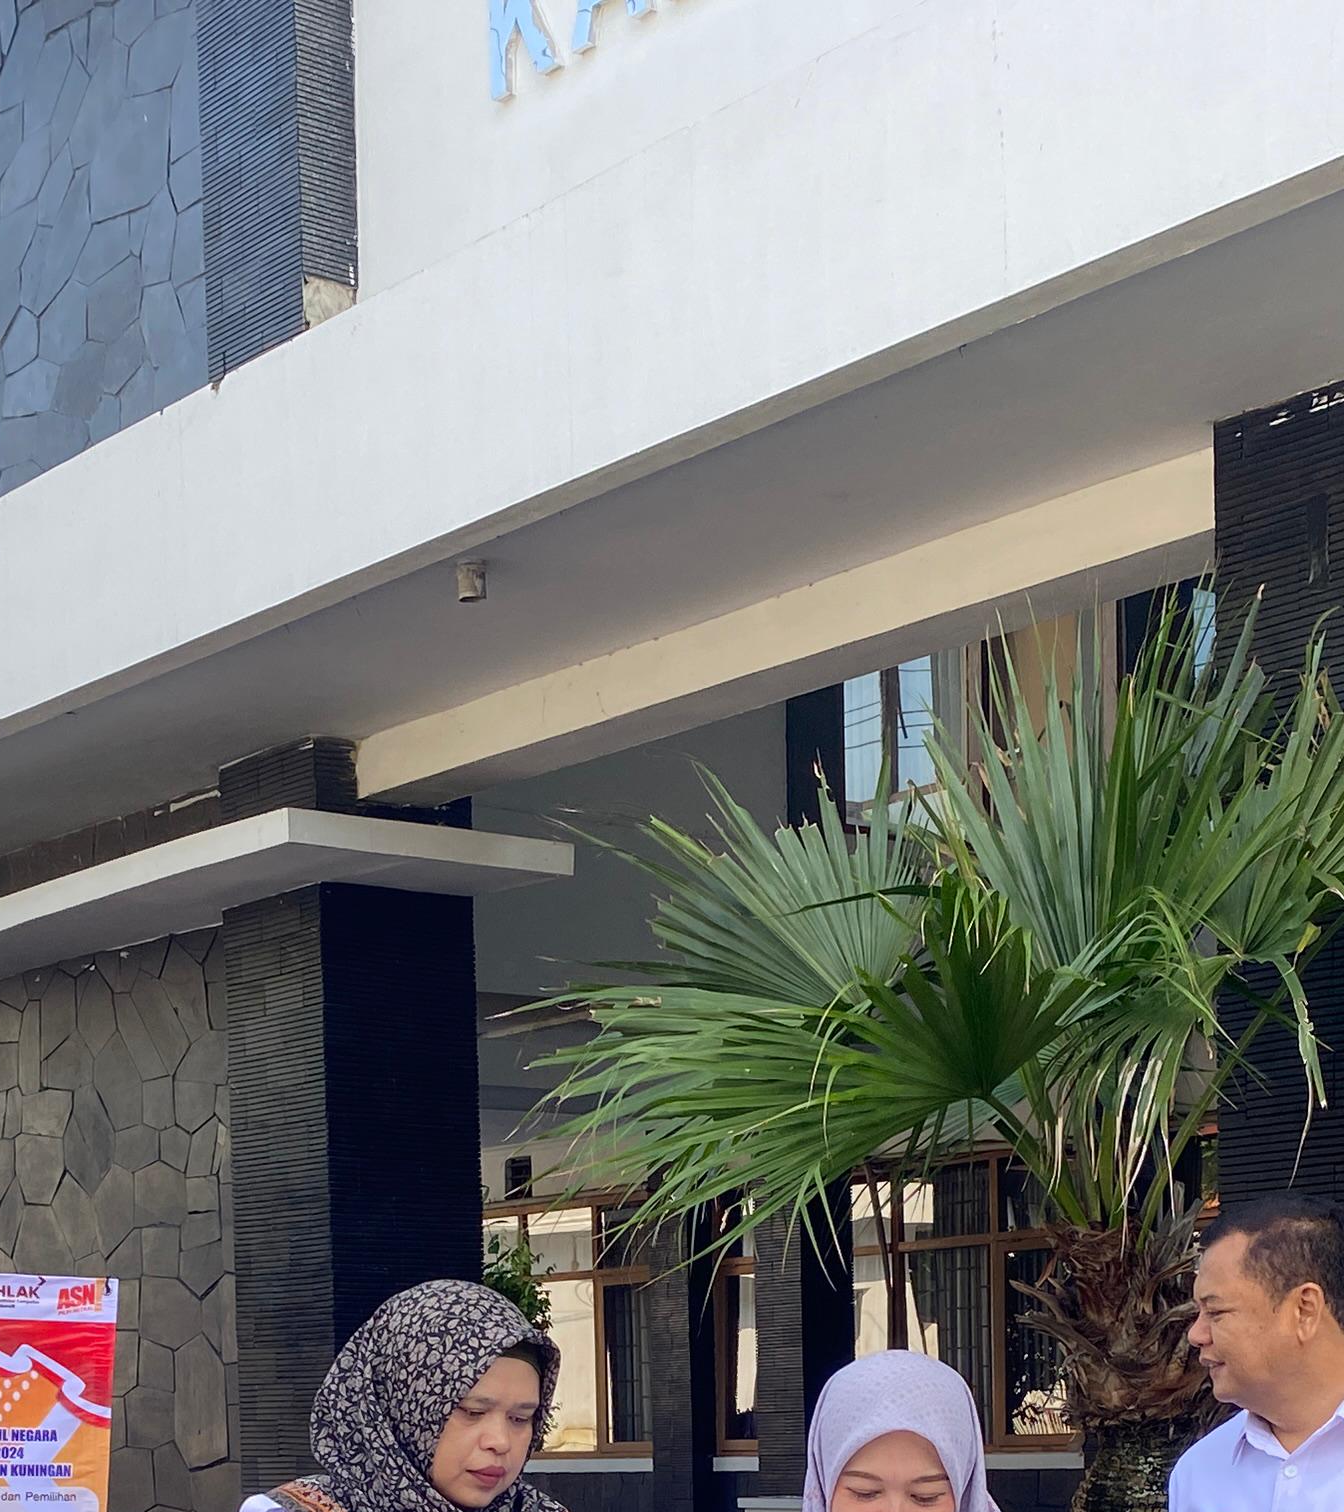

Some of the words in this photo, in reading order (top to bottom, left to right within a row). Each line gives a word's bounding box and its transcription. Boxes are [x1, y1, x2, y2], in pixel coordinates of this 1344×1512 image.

[11, 1428, 58, 1442] NEGARA
[10, 1464, 72, 1478] KUNINGAN
[1, 1491, 20, 1501] dan
[25, 1491, 77, 1502] Pemilihan
